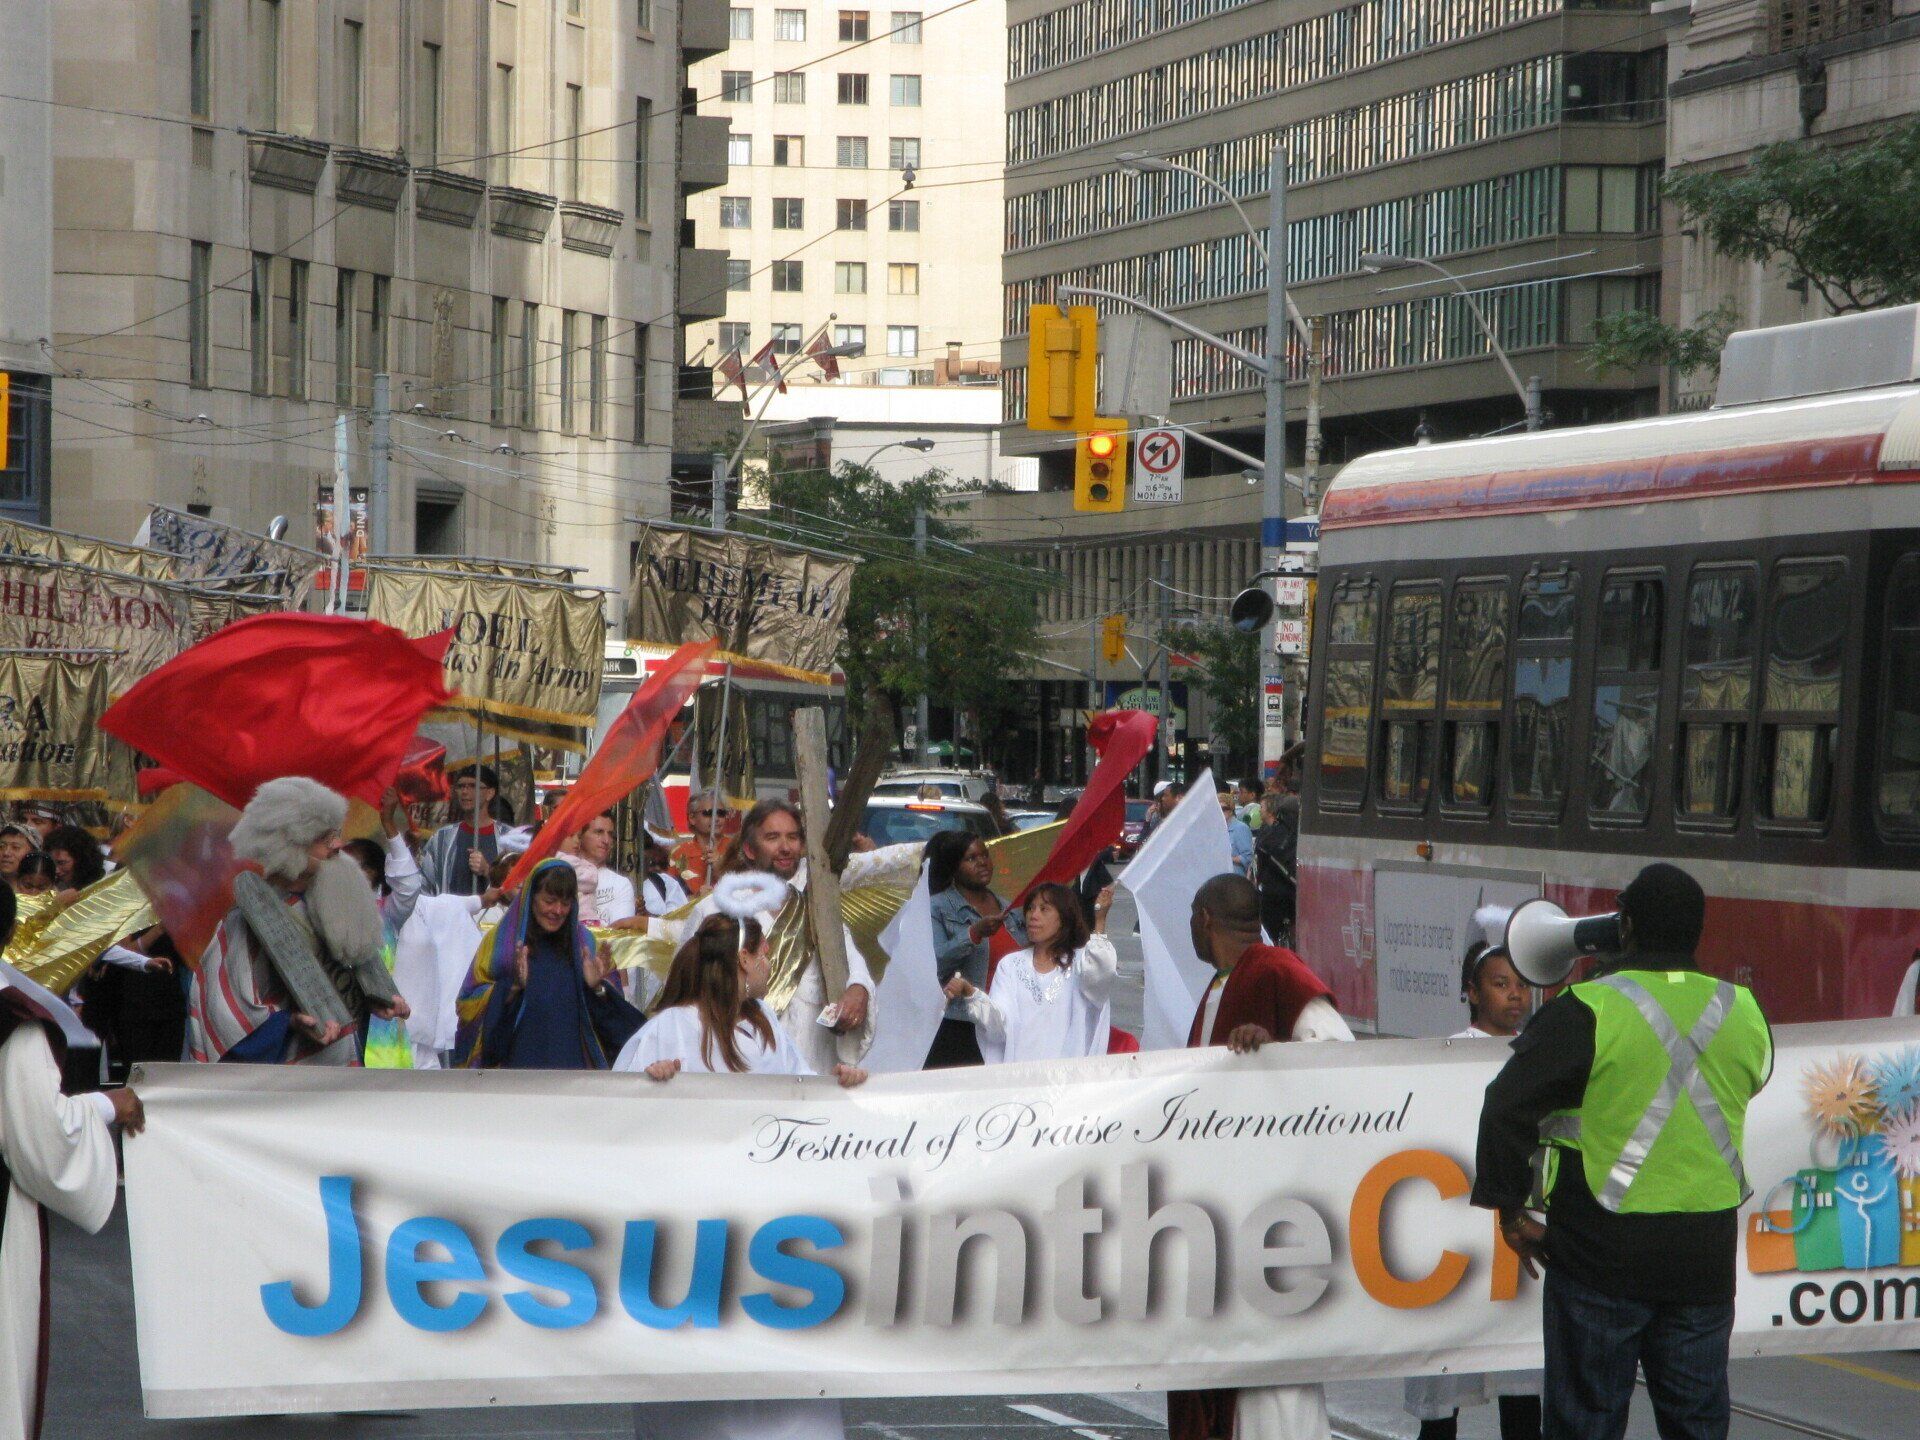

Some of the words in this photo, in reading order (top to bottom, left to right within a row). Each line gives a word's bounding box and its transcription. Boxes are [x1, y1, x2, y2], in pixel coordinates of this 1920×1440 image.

[1276, 633, 1303, 643] STANDING
[1283, 622, 1294, 633] NO
[527, 657, 594, 697] Army
[748, 1114, 918, 1163] Festival
[926, 1115, 971, 1172] of
[976, 1101, 1123, 1151] Praise
[1134, 1087, 1414, 1143] International
[1771, 1277, 1920, 1327] .com
